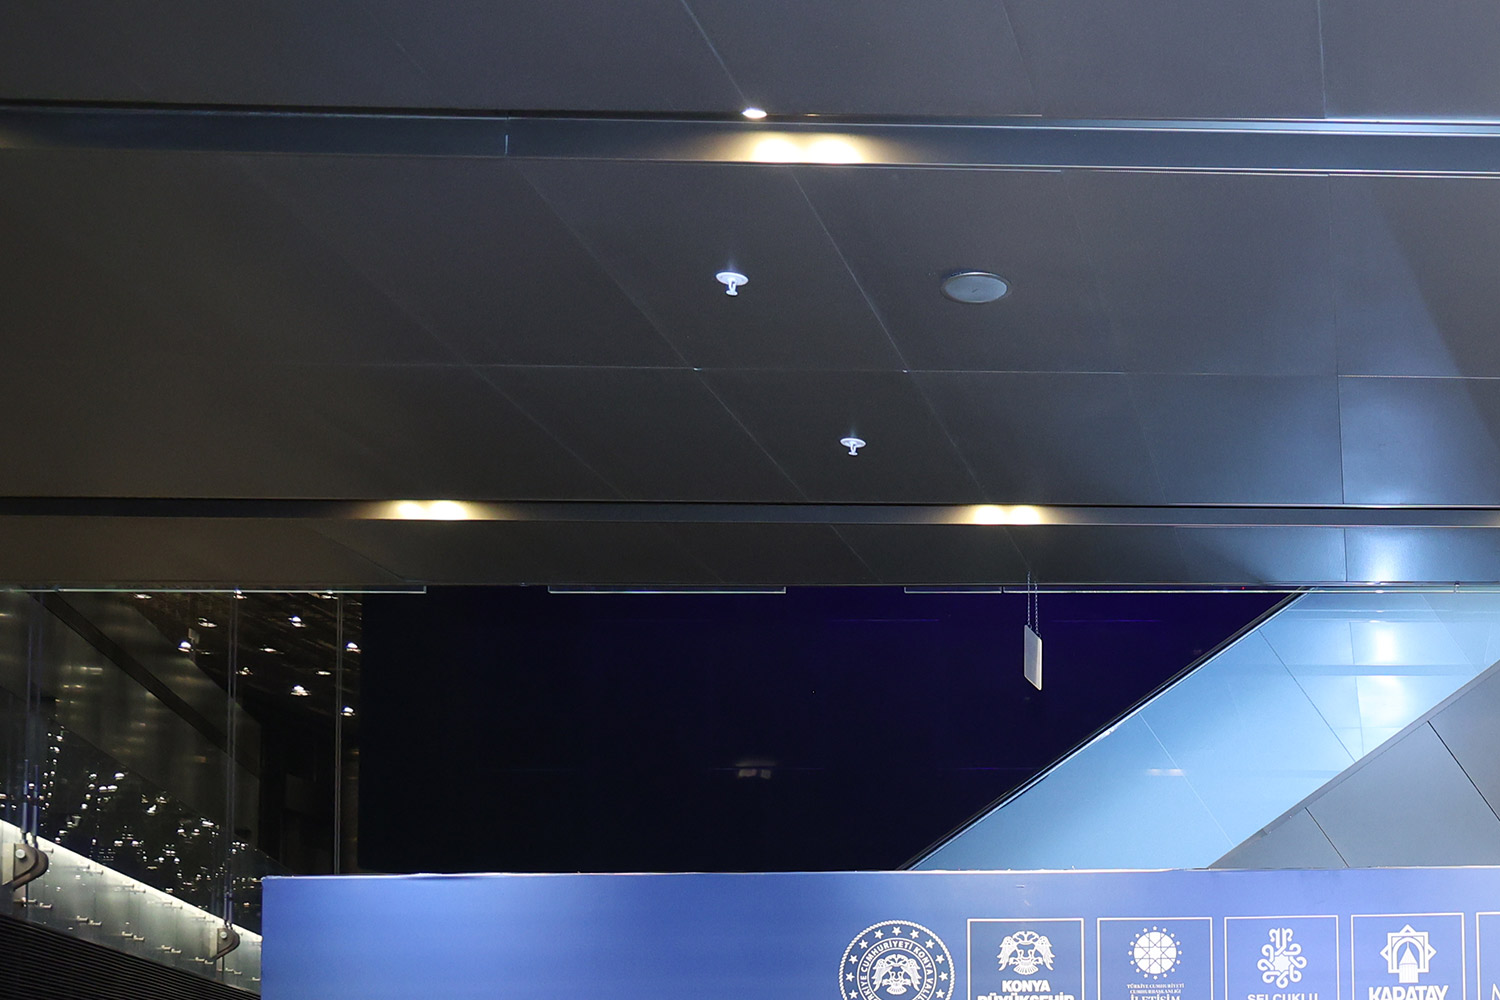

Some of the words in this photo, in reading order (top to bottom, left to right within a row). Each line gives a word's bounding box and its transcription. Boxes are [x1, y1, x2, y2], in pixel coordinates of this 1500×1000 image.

[860, 940, 914, 973] CUMHURİYETİ
[913, 946, 933, 975] KONYA
[1001, 980, 1051, 993] KONYA
